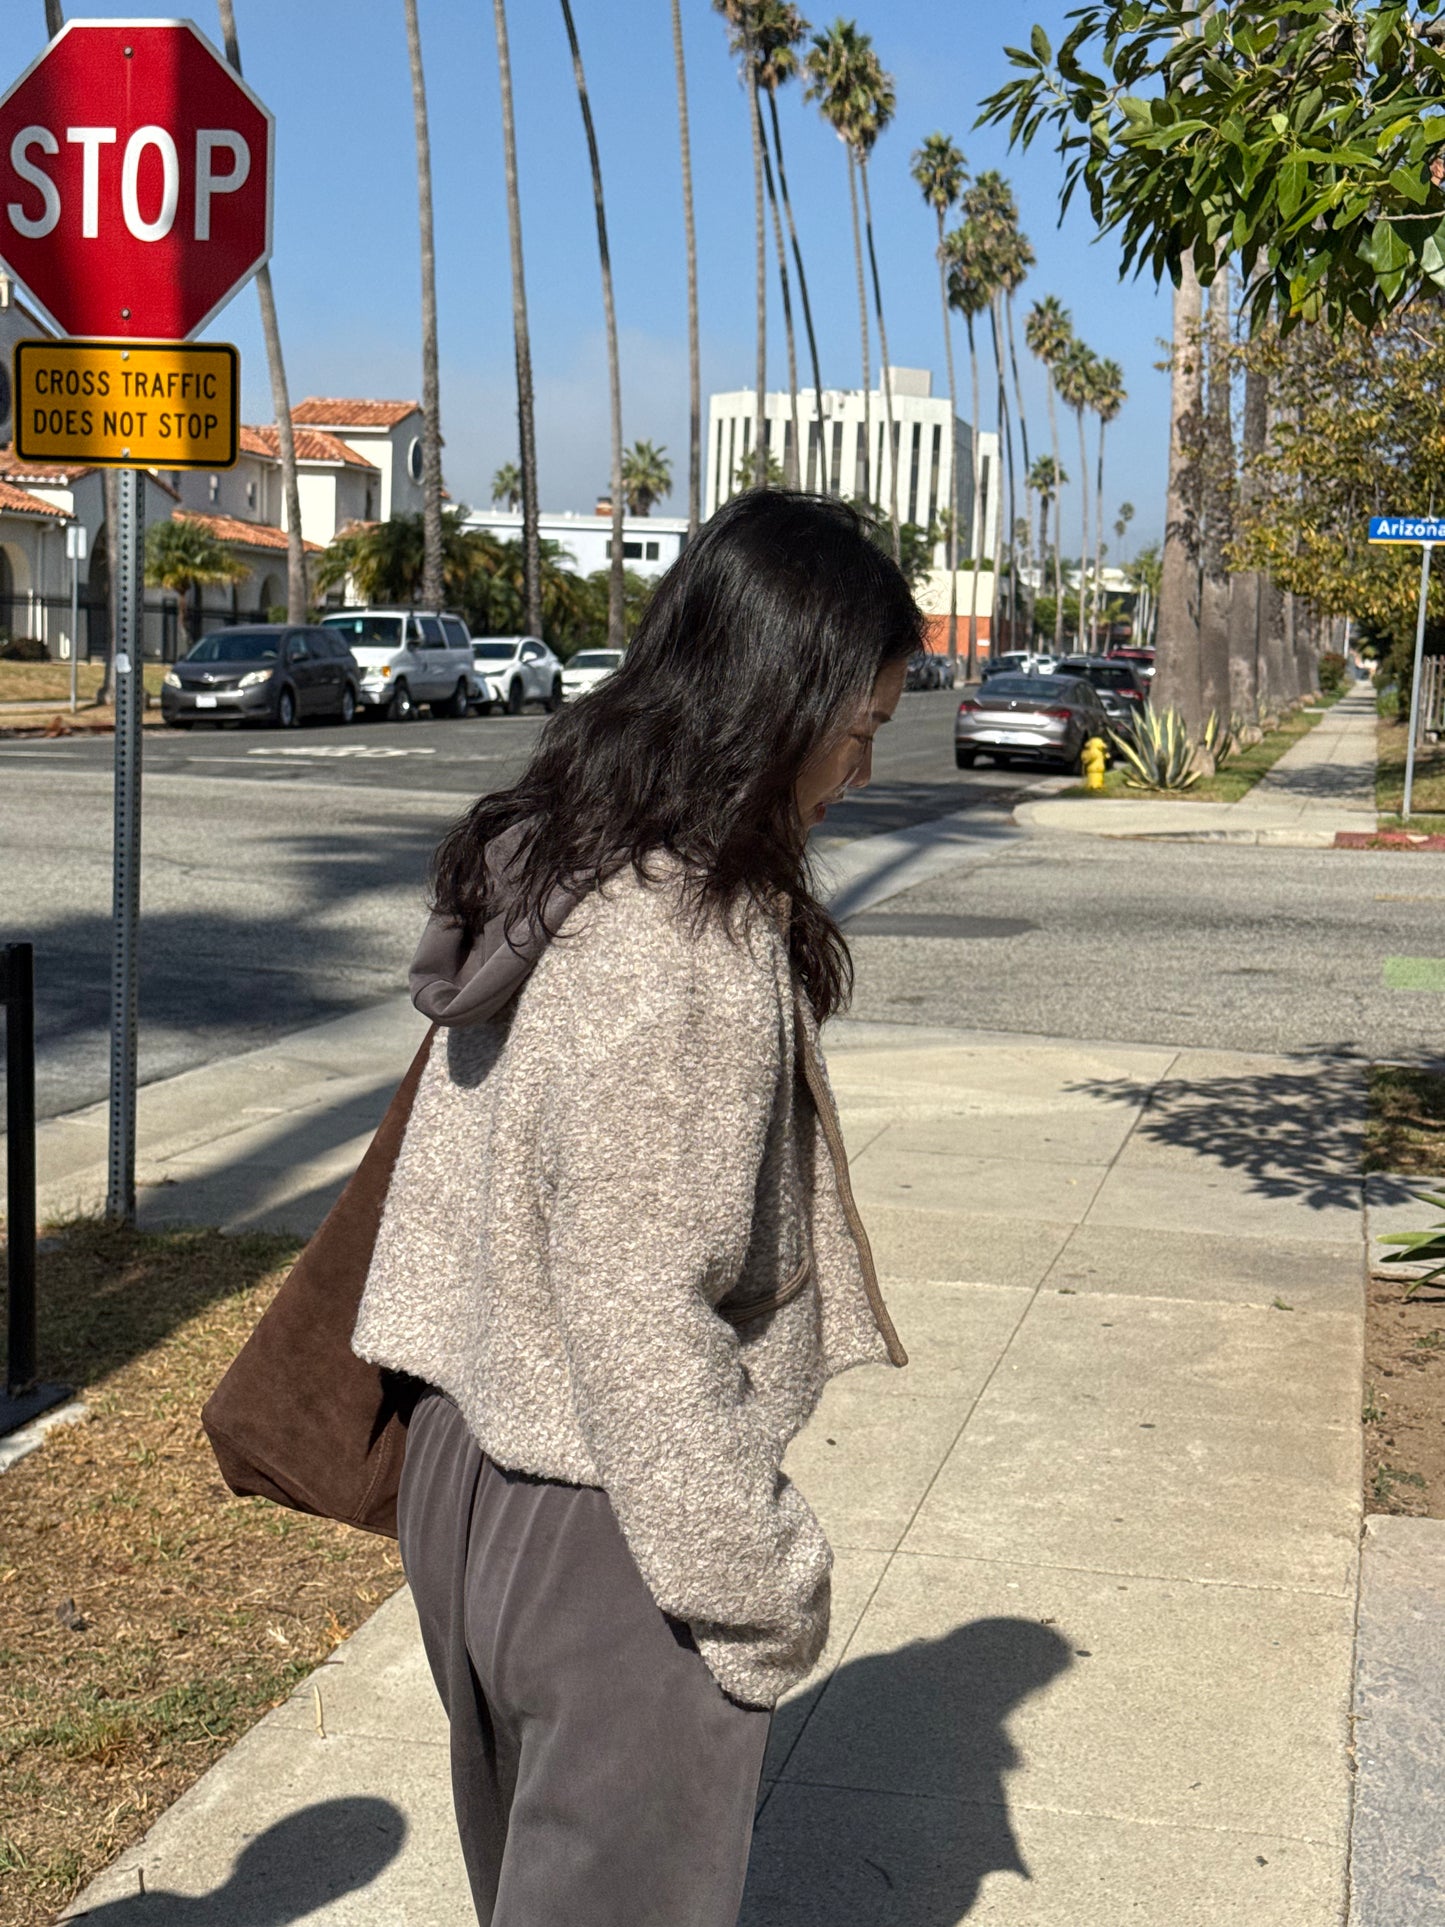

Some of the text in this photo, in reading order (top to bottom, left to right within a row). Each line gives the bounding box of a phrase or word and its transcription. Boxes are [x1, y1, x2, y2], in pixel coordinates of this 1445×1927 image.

[7, 125, 251, 242] STOP
[35, 369, 217, 399] CROSS TRAFFIC
[34, 409, 218, 439] DOES NOT STOP
[1376, 519, 1445, 537] Arizona
